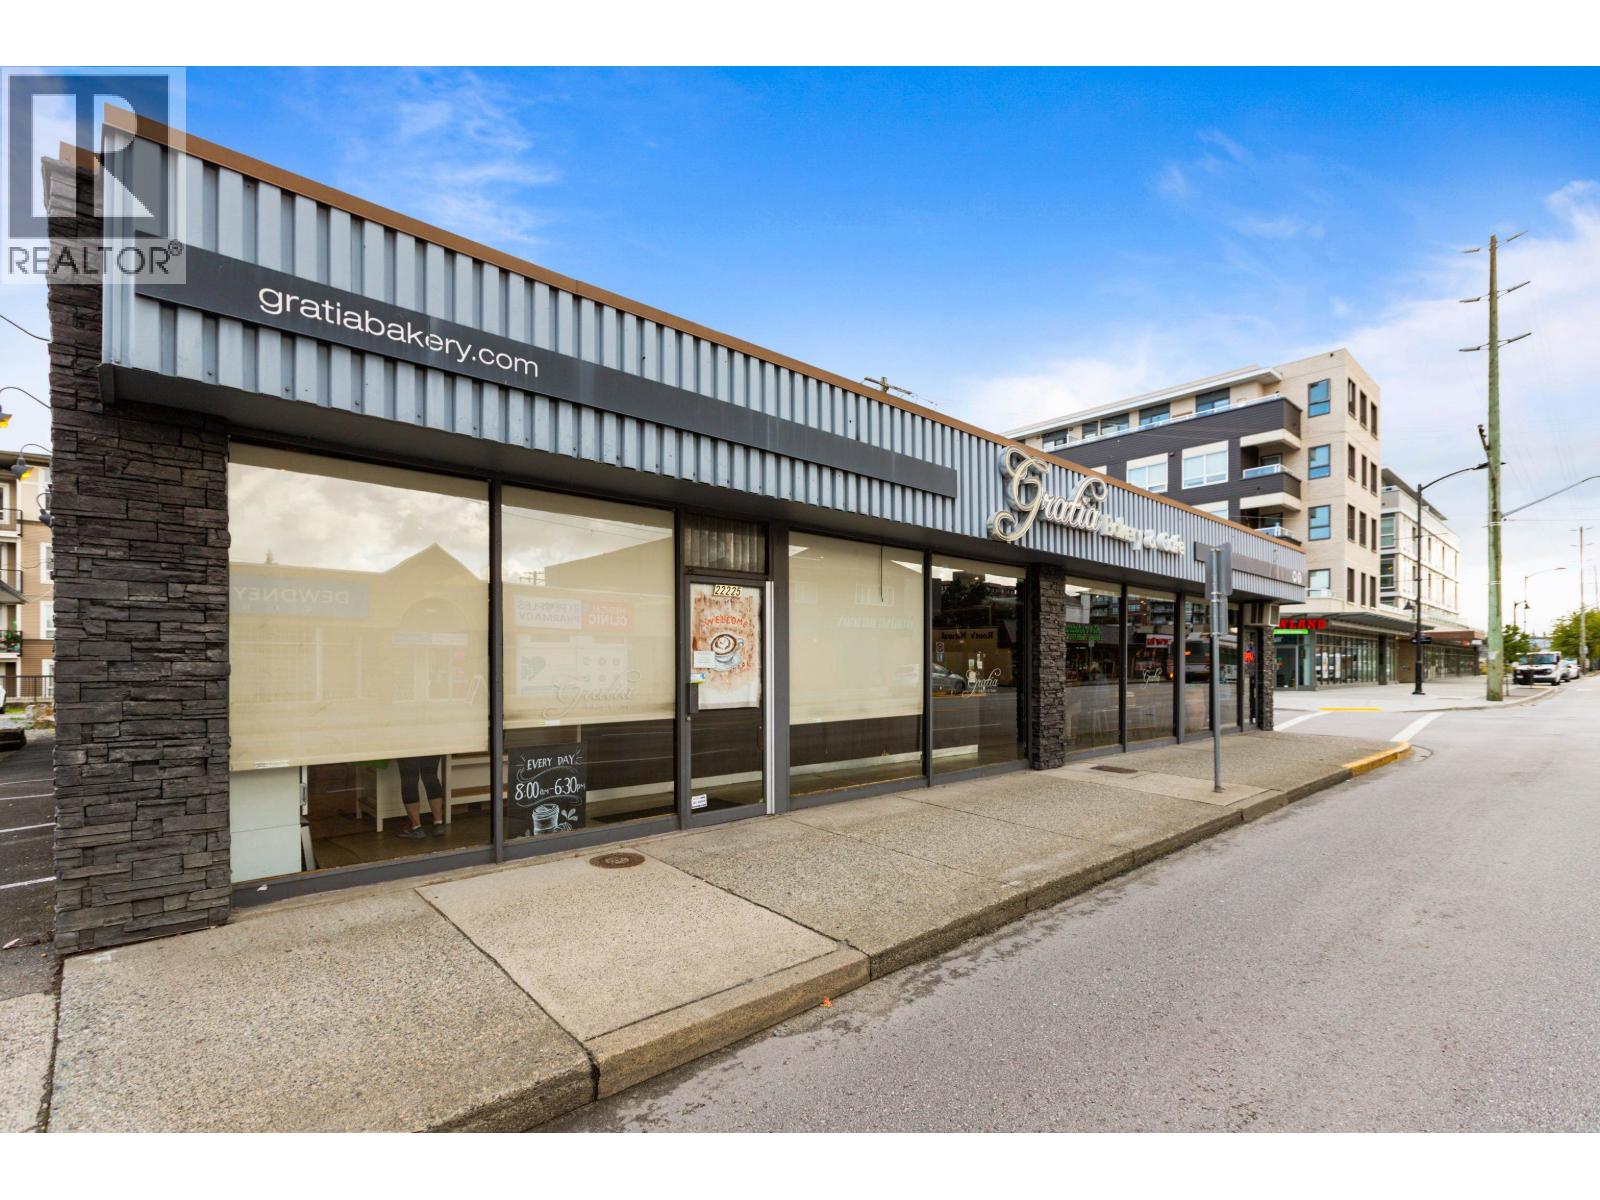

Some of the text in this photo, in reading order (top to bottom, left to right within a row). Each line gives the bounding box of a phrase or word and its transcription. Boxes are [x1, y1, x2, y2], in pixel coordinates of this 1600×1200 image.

[258, 287, 539, 377] gratiabakery.com
[988, 445, 1108, 542] Gratia
[714, 585, 742, 597] 22225
[704, 615, 748, 628] WELCOME
[526, 754, 576, 771] EVERY DAY
